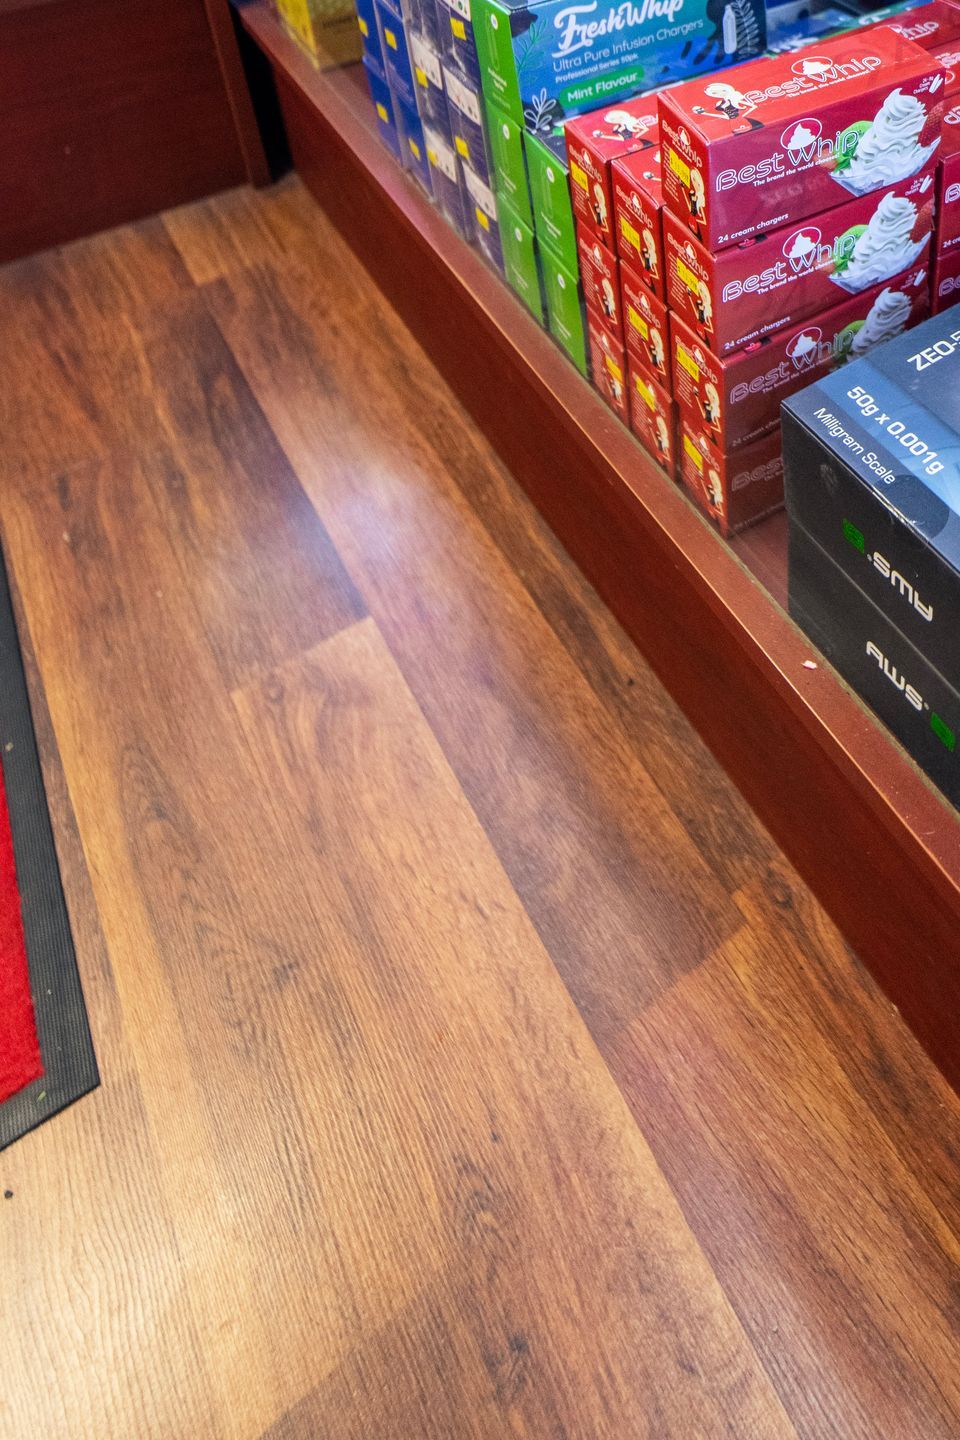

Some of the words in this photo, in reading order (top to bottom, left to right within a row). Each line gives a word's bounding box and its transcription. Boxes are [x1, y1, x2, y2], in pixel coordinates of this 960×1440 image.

[552, 54, 582, 73] Ultra
[583, 48, 610, 64] Pure
[612, 36, 655, 57] Infusion
[655, 18, 704, 42] Chargers
[555, 68, 594, 84] Professional
[593, 59, 619, 73] Series
[566, 84, 593, 102] Mint
[594, 71, 638, 98] Flavour
[743, 74, 813, 105] Best
[806, 56, 882, 85] Whip
[715, 151, 785, 193] Best
[787, 130, 861, 166] Whip
[752, 176, 765, 187] The
[765, 169, 786, 184] brand
[786, 167, 796, 177] the
[797, 160, 815, 174] world
[717, 234, 729, 244] 24
[730, 225, 755, 241] cream
[755, 212, 789, 232] chargers
[722, 261, 787, 303] Best
[789, 234, 856, 274] Whip
[724, 341, 735, 350] 24
[735, 332, 759, 347] cream
[759, 315, 791, 338] chargers
[730, 362, 790, 405] Best
[813, 406, 864, 458] Milligram
[861, 450, 896, 486] Scale
[847, 385, 881, 417] 50g
[875, 412, 891, 425] x
[886, 420, 945, 477] 0.001g
[872, 551, 934, 623] AWS
[866, 640, 923, 712] AWS
